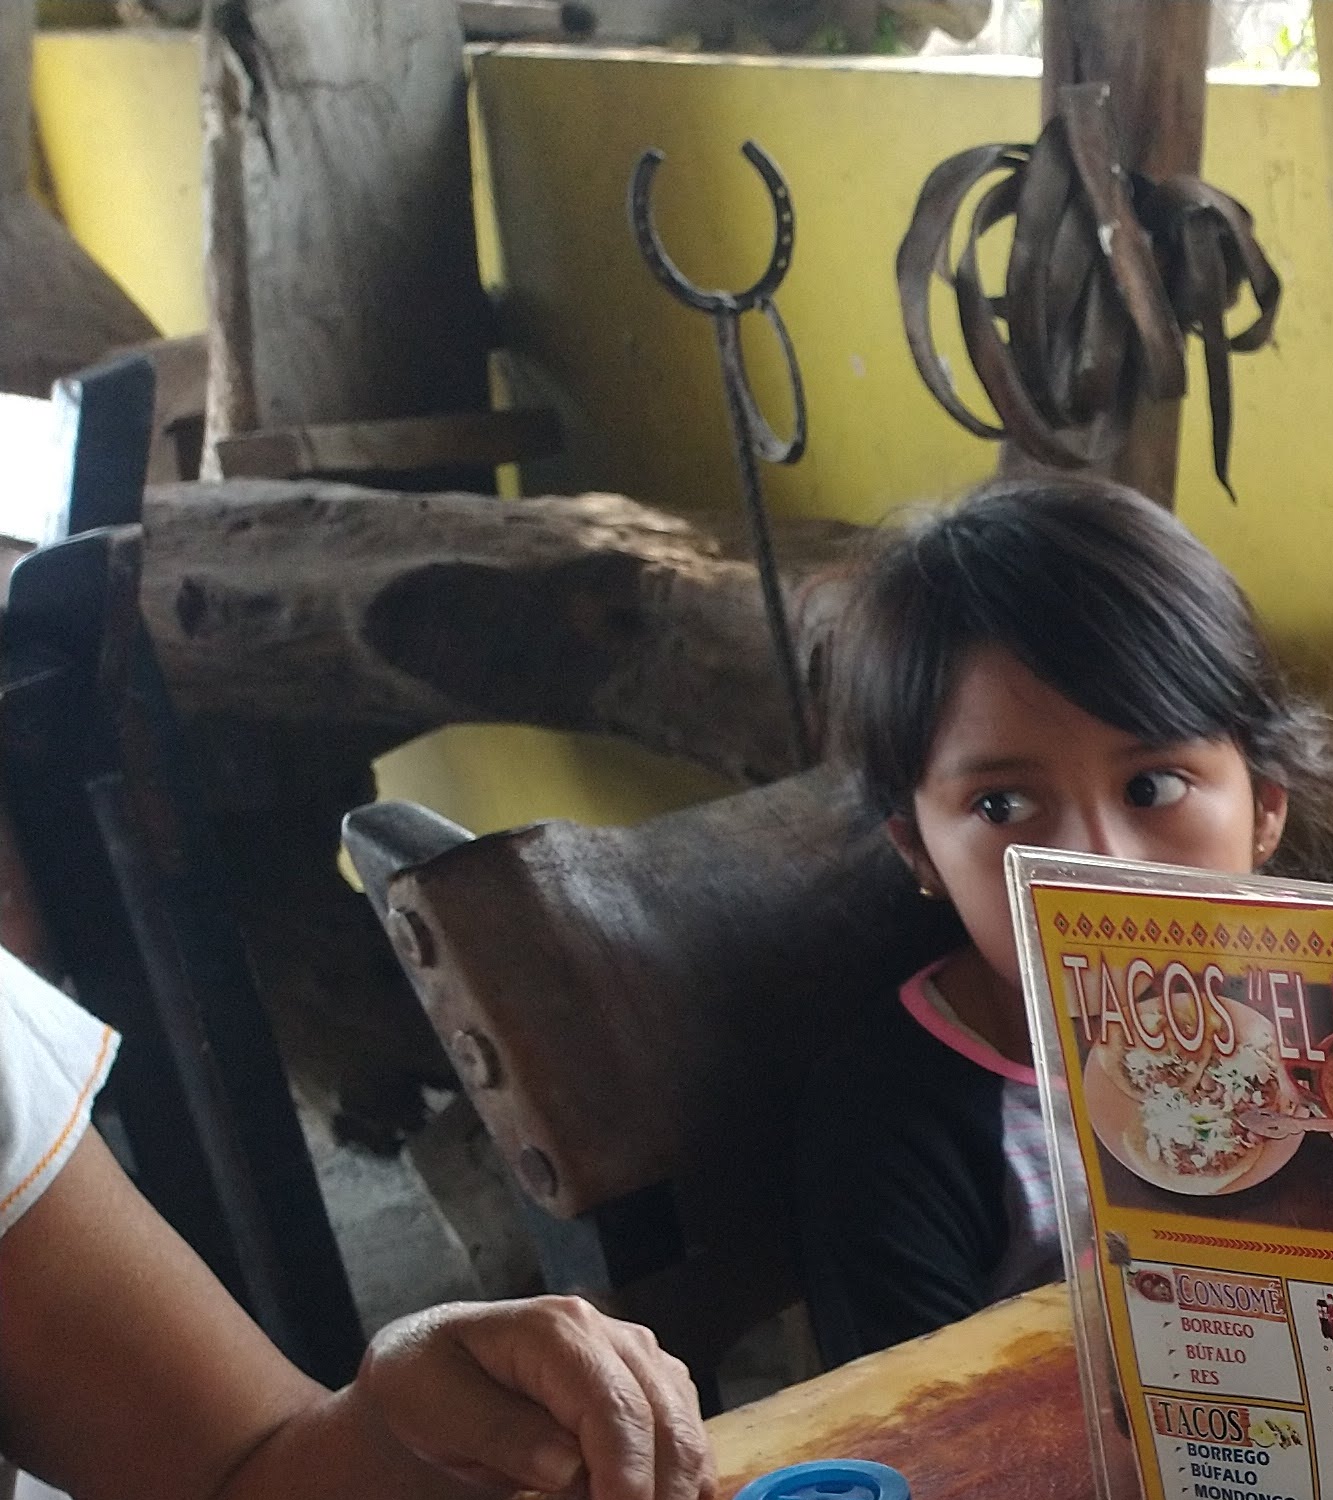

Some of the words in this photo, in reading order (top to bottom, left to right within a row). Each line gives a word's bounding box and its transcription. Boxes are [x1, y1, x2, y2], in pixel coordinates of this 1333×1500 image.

[1061, 954, 1236, 1057] TACOS
[1178, 1273, 1286, 1316] CONSOMÉ
[1181, 1317, 1254, 1338] BORREGO
[1185, 1343, 1246, 1364] BÚFALO
[1190, 1368, 1219, 1385] RES
[1158, 1401, 1243, 1442] TACOS
[1186, 1442, 1270, 1466] BORREGO
[1190, 1462, 1258, 1486] BÚFALO
